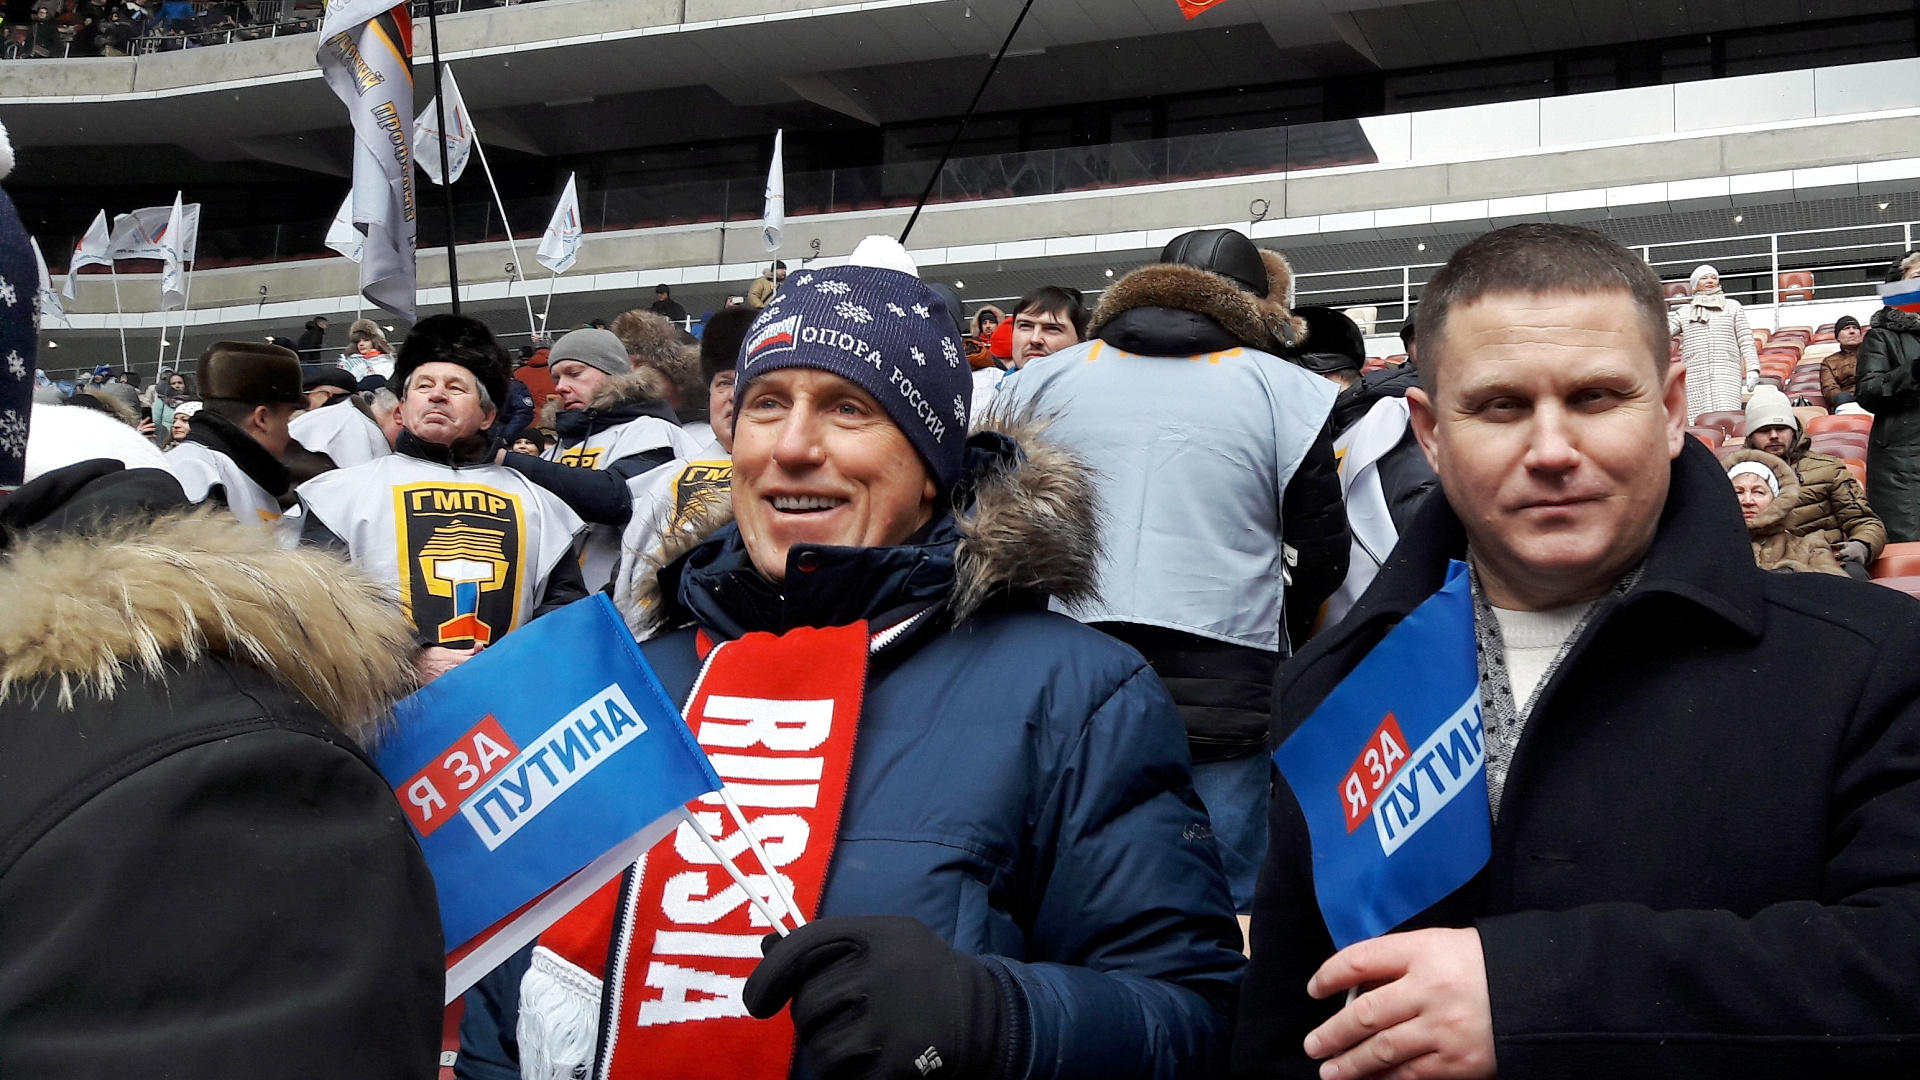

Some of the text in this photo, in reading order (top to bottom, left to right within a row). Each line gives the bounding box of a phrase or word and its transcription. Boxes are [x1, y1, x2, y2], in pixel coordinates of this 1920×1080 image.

[801, 326, 946, 444] ОПОРА РОССИИ
[411, 490, 507, 515] ГМПР
[407, 731, 511, 822] Я ЗА
[473, 698, 637, 836] ПУТИНА
[1345, 729, 1406, 819] Я ЗА
[1380, 704, 1484, 840] ПУТИН
[637, 694, 834, 1027] RUSSIA
